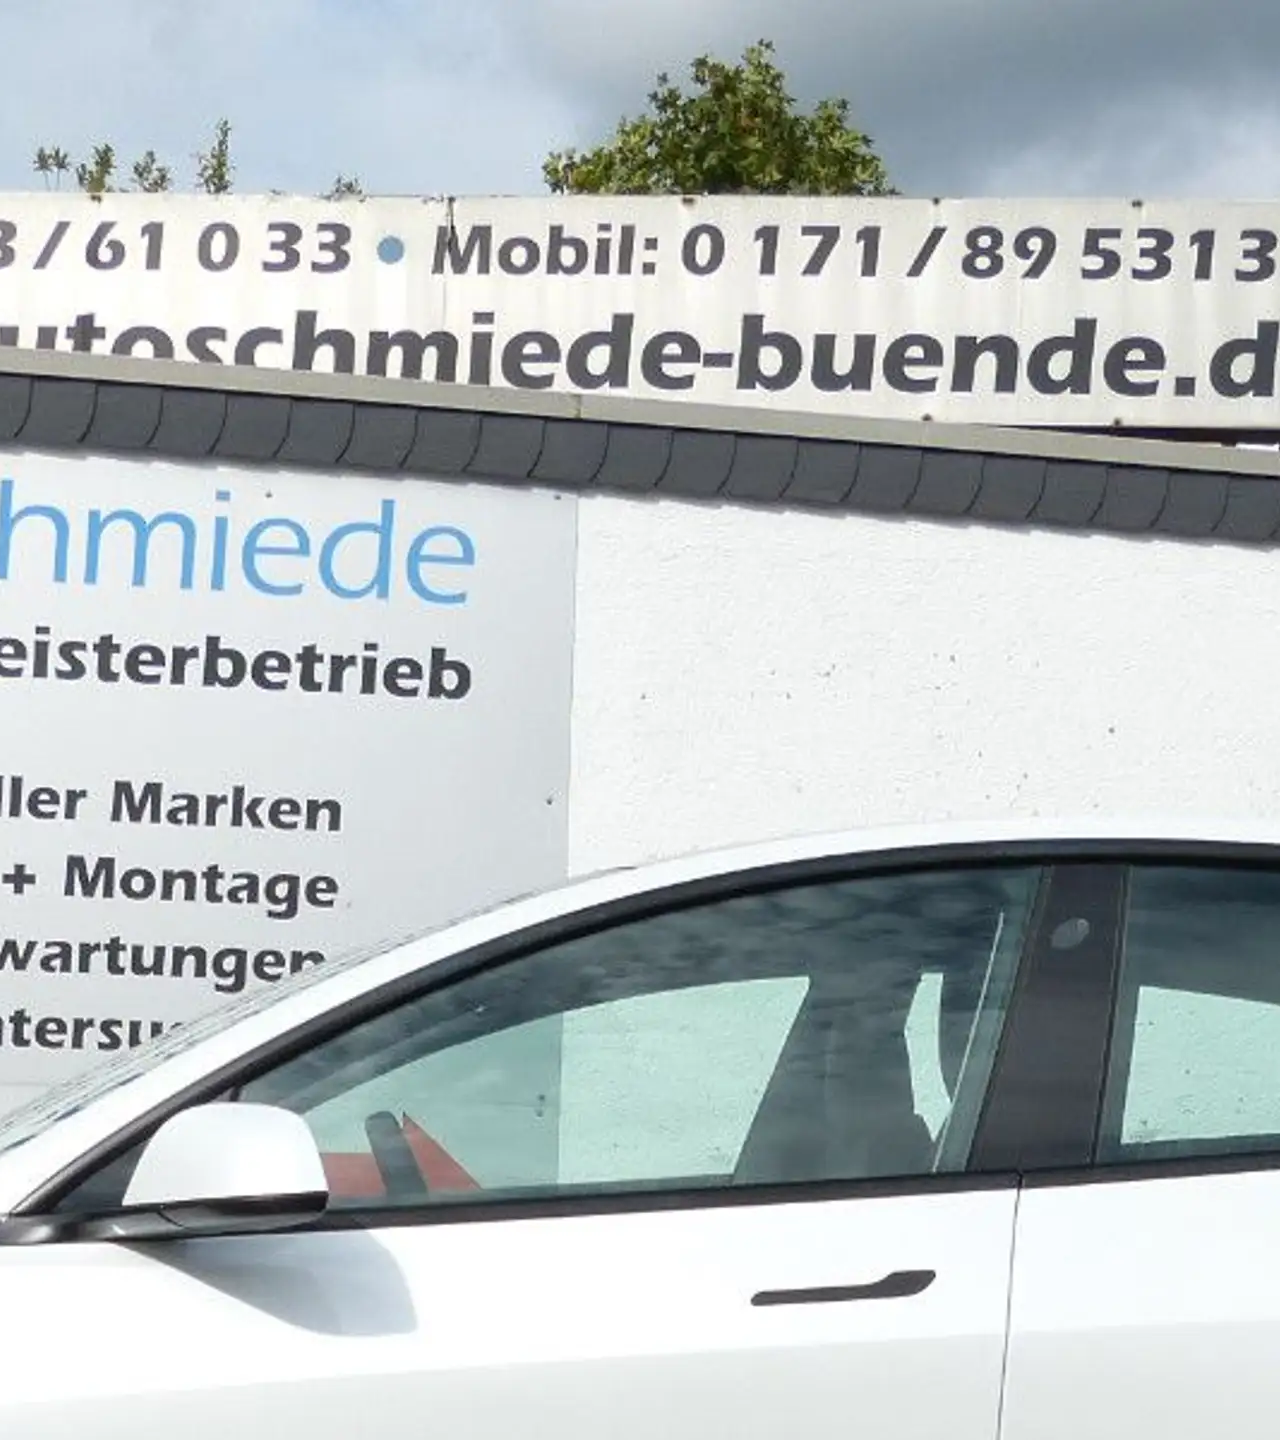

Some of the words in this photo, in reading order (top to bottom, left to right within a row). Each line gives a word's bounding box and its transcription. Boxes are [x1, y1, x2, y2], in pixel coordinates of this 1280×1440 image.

[430, 223, 659, 276] Mobil:
[109, 779, 343, 833] Marken
[1, 862, 37, 896] +
[62, 853, 340, 921] Montage
